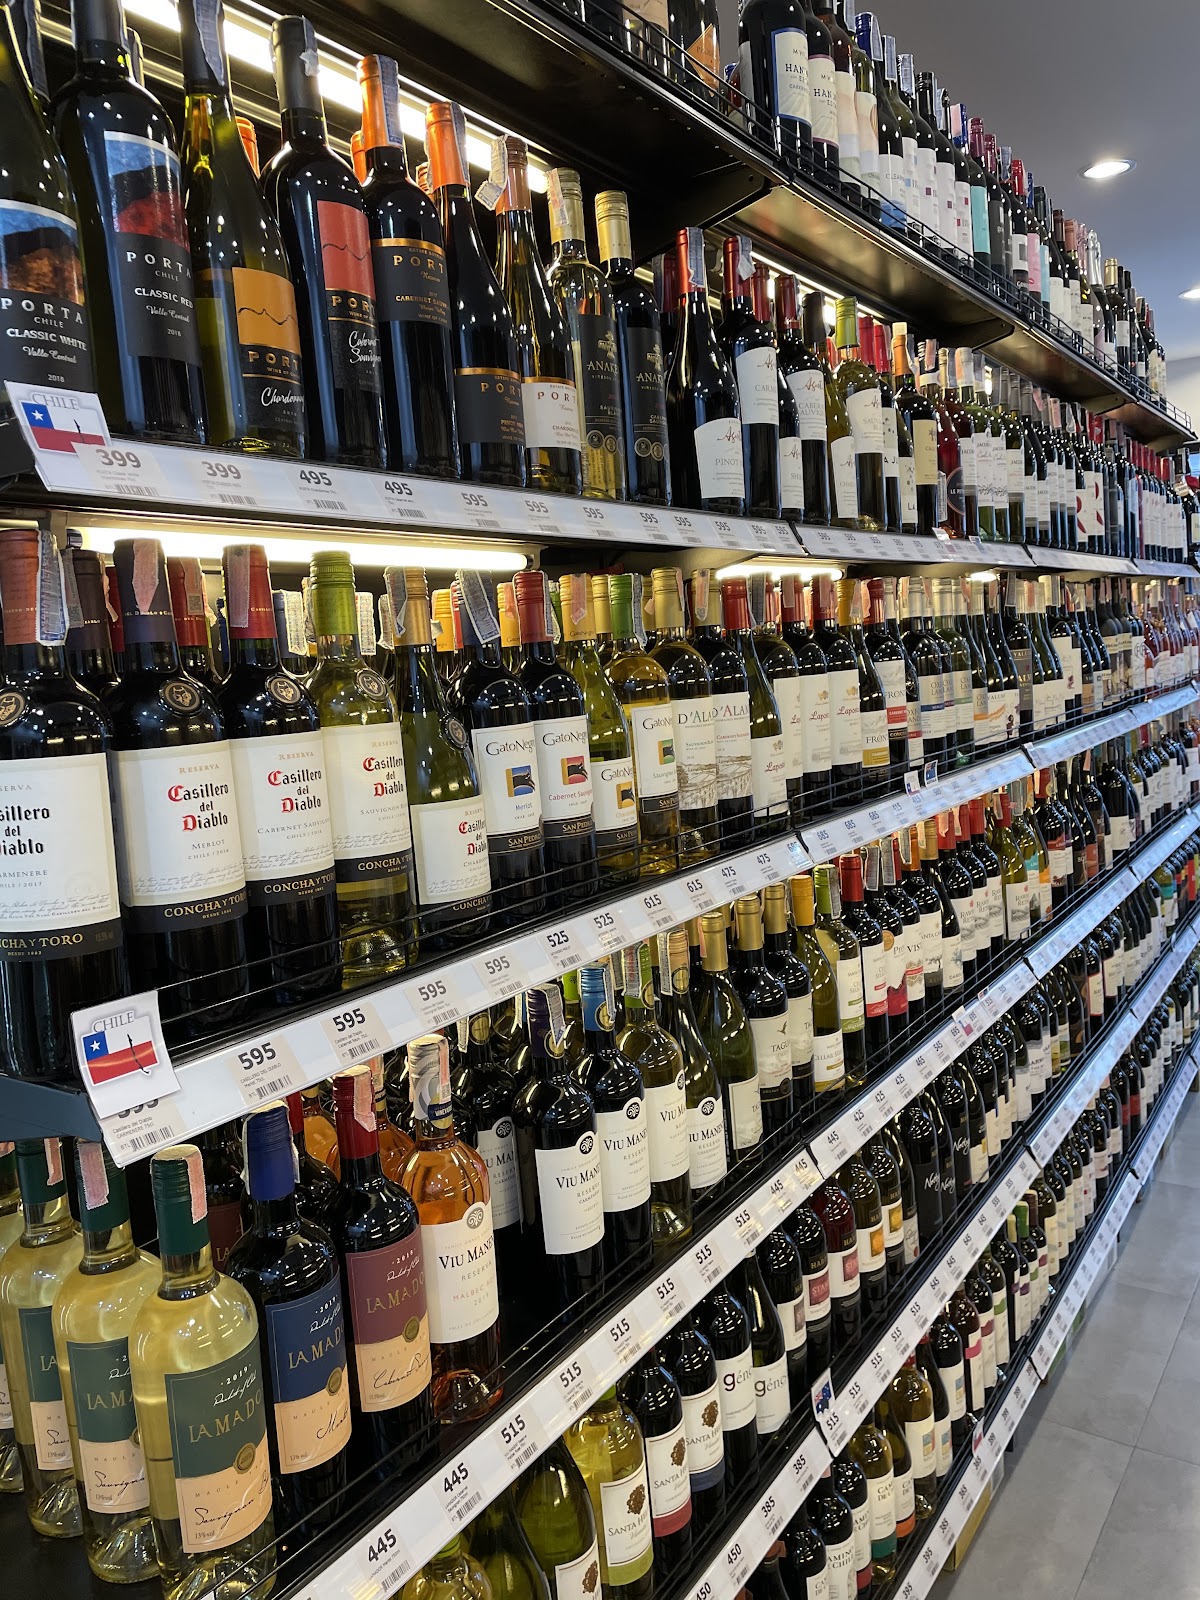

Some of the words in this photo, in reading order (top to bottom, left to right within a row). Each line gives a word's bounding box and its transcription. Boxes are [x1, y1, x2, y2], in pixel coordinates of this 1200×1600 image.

[126, 251, 192, 279] PORTA
[393, 255, 444, 274] PORT
[155, 269, 179, 282] CHILE
[135, 287, 178, 303] CLASSIC
[180, 296, 194, 309] RED
[332, 295, 376, 314] PORT
[1, 297, 84, 325] PORTA
[146, 305, 168, 317] Valle
[34, 316, 64, 329] CHILE
[6, 328, 57, 343] CLASSIC
[60, 335, 87, 351] WHITE
[22, 346, 48, 359] Valle
[49, 349, 77, 364] Central
[248, 350, 299, 371] PORT
[48, 373, 65, 383] 2018
[31, 393, 79, 410] CHILE
[96, 448, 141, 468] 399
[201, 460, 242, 479] 399
[300, 469, 333, 486] 495
[384, 480, 413, 496] 495
[461, 492, 488, 507] 595
[525, 500, 549, 513] 595
[583, 507, 604, 519] 595
[640, 512, 658, 524] 595
[674, 516, 692, 527] 595
[715, 521, 731, 531] 595
[751, 524, 766, 534] 595
[775, 525, 788, 535] 595
[542, 730, 587, 747] GatoNeg
[485, 739, 535, 756] GatoNegr
[279, 752, 314, 761] RESERVA
[179, 763, 219, 774] RESERVA
[386, 771, 396, 780] del
[267, 769, 322, 786] Casillero
[167, 782, 229, 803] Casillero
[297, 786, 309, 796] del
[549, 792, 577, 801] Cabernet
[0, 805, 50, 822] sillero
[199, 800, 214, 812] del
[281, 796, 322, 814] Diablo
[360, 805, 401, 816] SAUVIGNON
[516, 802, 533, 811] Merlot
[182, 812, 228, 832] Diablo
[257, 824, 302, 834] CABERNET
[4, 825, 21, 837] del
[192, 839, 225, 850] MERLOT
[187, 852, 211, 860] CHILE
[757, 853, 770, 865] 475
[0, 869, 48, 879] ARMENERE
[721, 865, 737, 878] 475
[264, 878, 316, 894] CONCHA
[687, 879, 703, 893] 615
[164, 899, 222, 918] CONCHA
[644, 894, 662, 909] 615
[593, 912, 614, 929] 525
[29, 939, 37, 947] Y
[39, 933, 84, 947] TORO
[547, 930, 569, 948] 525
[485, 955, 510, 975] 595
[418, 980, 446, 1002] 595
[93, 1012, 134, 1033] CHILE
[332, 1007, 366, 1033] 595
[238, 1042, 277, 1070] 595
[240, 1071, 260, 1084] CASILLERO
[260, 1068, 268, 1076] DEL
[268, 1063, 282, 1073] DIABLO
[895, 1073, 905, 1086] 425
[875, 1090, 886, 1104] 425
[854, 1109, 865, 1123] 425
[112, 1124, 131, 1134] Casillero
[603, 1138, 624, 1151] VIU
[626, 1128, 648, 1147] MANE
[827, 1131, 840, 1145] 445
[794, 1158, 808, 1174] 445
[555, 1175, 578, 1189] VIU
[770, 1179, 784, 1196] 445
[735, 1209, 750, 1228] 515
[439, 1254, 464, 1270] VIU
[467, 1236, 494, 1263] MANE
[695, 1244, 712, 1265] 515
[946, 1255, 956, 1269] 645
[461, 1260, 492, 1282] RESERVA
[656, 1277, 675, 1300] 515
[930, 1277, 940, 1291] 645
[367, 1297, 386, 1315] LA
[388, 1271, 424, 1309] MADO
[453, 1284, 484, 1302] MALBEC
[910, 1301, 921, 1317] 515
[609, 1318, 630, 1342] 515
[891, 1326, 902, 1342] 515
[289, 1350, 308, 1370] LA
[311, 1320, 344, 1362] MADO
[40, 1355, 57, 1372] LA
[870, 1353, 883, 1369] 515
[226, 1366, 248, 1385] 2019
[560, 1361, 581, 1388] 515
[848, 1381, 862, 1399] 515
[87, 1393, 108, 1411] LA
[188, 1421, 213, 1443] LA
[215, 1387, 262, 1437] MADO
[826, 1412, 840, 1431] 515
[500, 1414, 526, 1444] 515
[685, 1434, 711, 1446] SANTA
[792, 1454, 806, 1475] 385
[94, 1470, 146, 1496] Sauvigno
[443, 1462, 469, 1493] 445
[654, 1474, 680, 1490] SANTA
[195, 1479, 240, 1498] MAULE
[195, 1498, 255, 1530] Sauvignon
[761, 1496, 776, 1518] 385
[608, 1524, 637, 1537] SANTA
[368, 1528, 397, 1563] 445
[727, 1543, 742, 1565] 450
[922, 1547, 934, 1563] 395
[902, 1582, 914, 1600] 395
